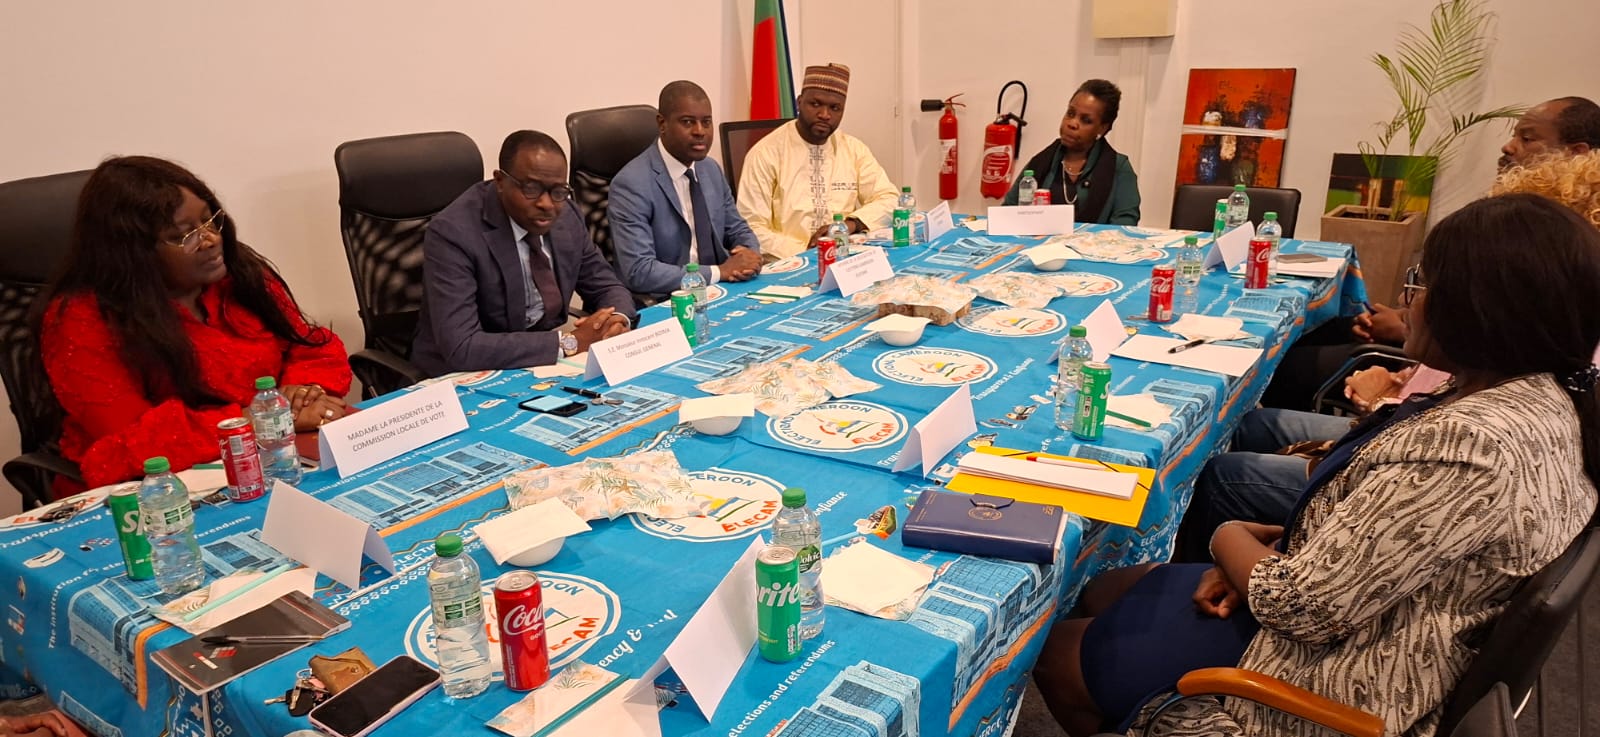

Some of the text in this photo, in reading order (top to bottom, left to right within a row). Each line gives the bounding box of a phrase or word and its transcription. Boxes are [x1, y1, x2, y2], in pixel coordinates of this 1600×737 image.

[347, 425, 379, 441] MADAME
[380, 422, 388, 431] LA
[425, 404, 435, 412] DE
[434, 400, 443, 409] LA
[352, 429, 396, 452] COMMISSION
[396, 422, 421, 436] LOCALE
[421, 418, 429, 427] DE
[428, 411, 446, 423] VOTE
[0, 514, 102, 549] ransparency
[193, 515, 252, 539] ferendums
[721, 499, 779, 533] ELECAM
[800, 551, 820, 564] olvic
[757, 582, 800, 607] rite
[728, 639, 836, 737] elections and referendums
